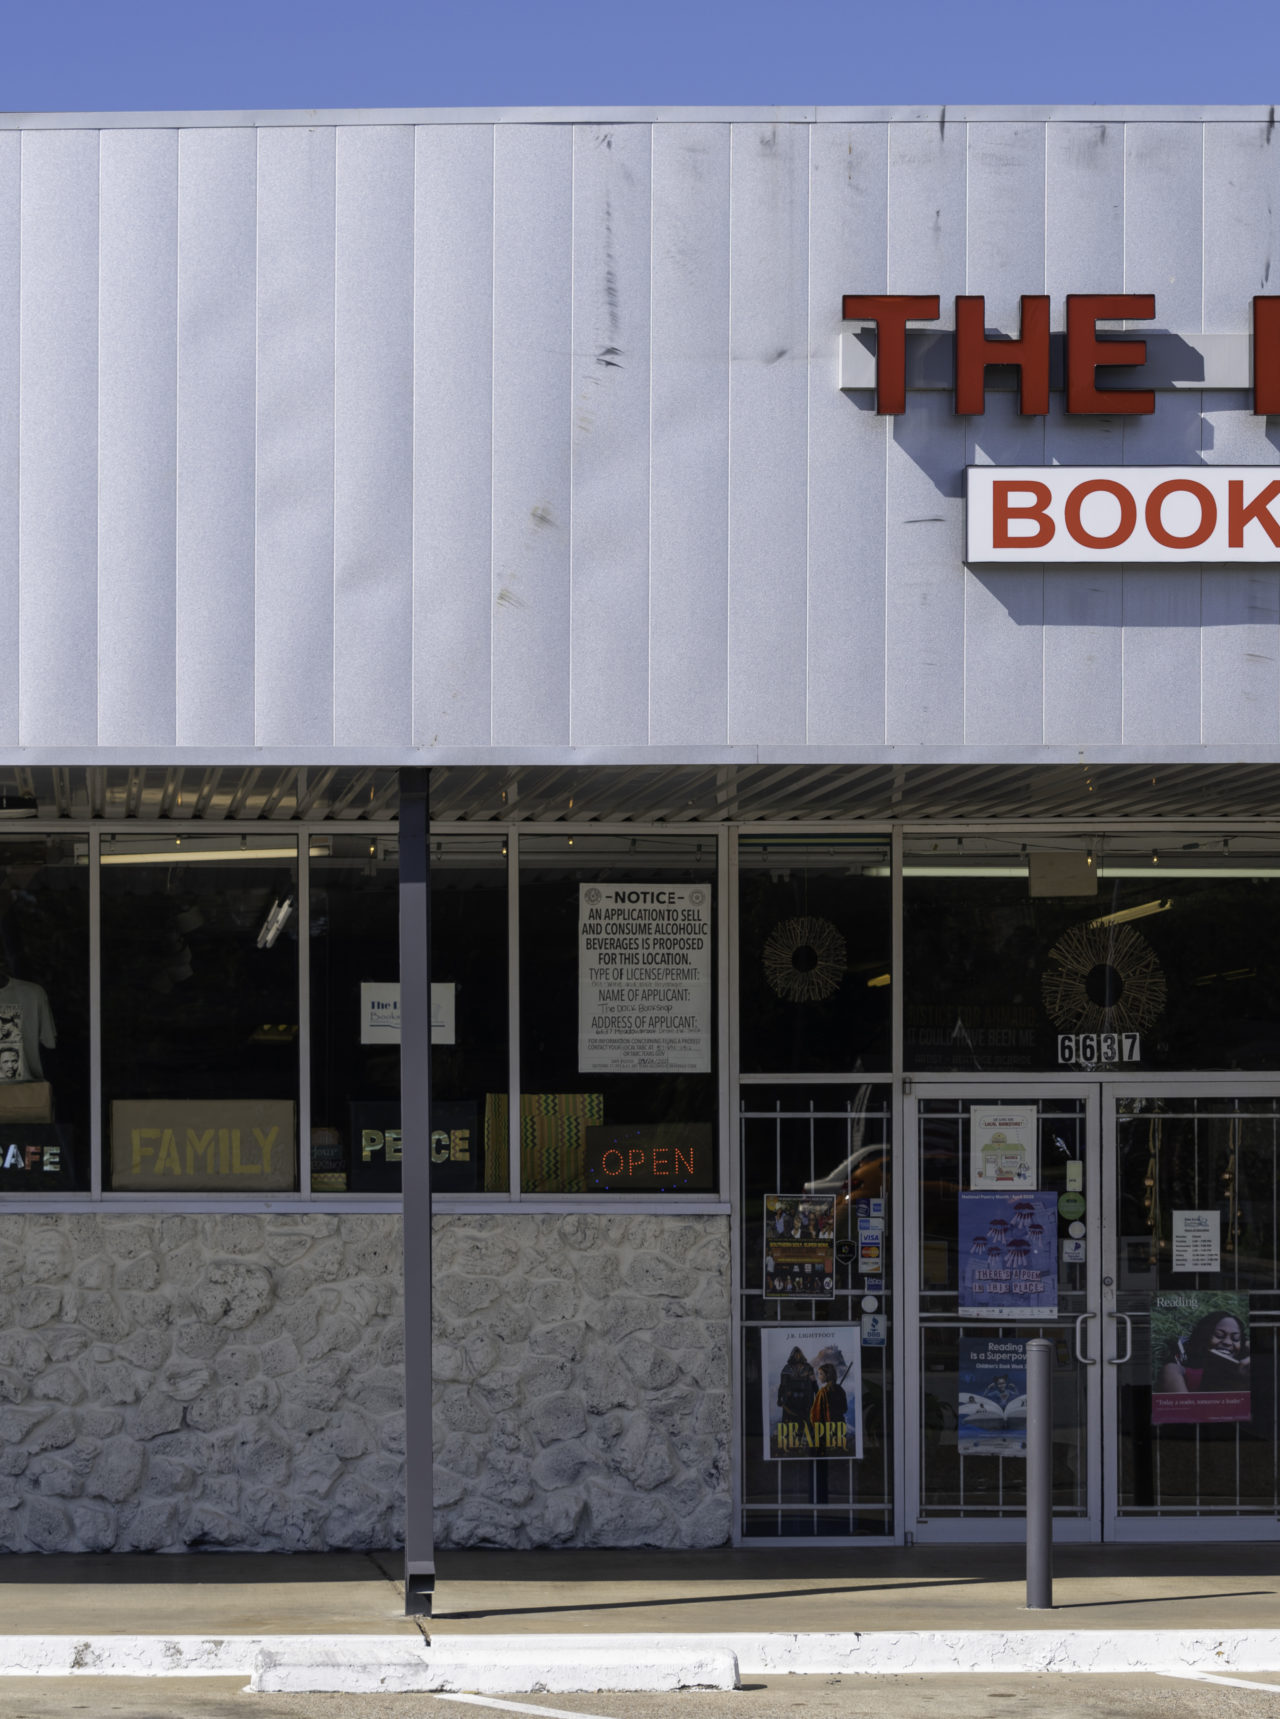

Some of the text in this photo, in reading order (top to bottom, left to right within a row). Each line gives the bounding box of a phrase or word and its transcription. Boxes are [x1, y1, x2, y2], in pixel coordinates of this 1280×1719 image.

[843, 294, 1156, 416] THE
[588, 909, 602, 921] AN
[681, 909, 702, 921] SELL
[582, 923, 708, 935] AND CONSUME ALCOHOLIC
[586, 938, 704, 950] BEVERAGES IS PROPOSED
[598, 953, 692, 965] FOR THIS LOCATION.
[589, 968, 700, 981] TYPE OF LICENSE/PERMIT:
[599, 989, 691, 1001] NAME OF APPLICANT:
[371, 1001, 390, 1010] The
[591, 1016, 698, 1029] ADDRESS OF APPLICANT:
[1060, 1034, 1137, 1062] 6637
[131, 1126, 281, 1175] FAMILY
[362, 1129, 471, 1163] PECE
[0, 1144, 61, 1172] AFE
[602, 1147, 695, 1176] OPEN
[976, 1270, 1041, 1280] THERE'S A POEM
[973, 1283, 984, 1292] IN
[987, 1282, 1009, 1292] THIS
[988, 1342, 1023, 1352] Reading
[970, 1352, 978, 1360] is
[777, 1421, 848, 1453] REAPER
